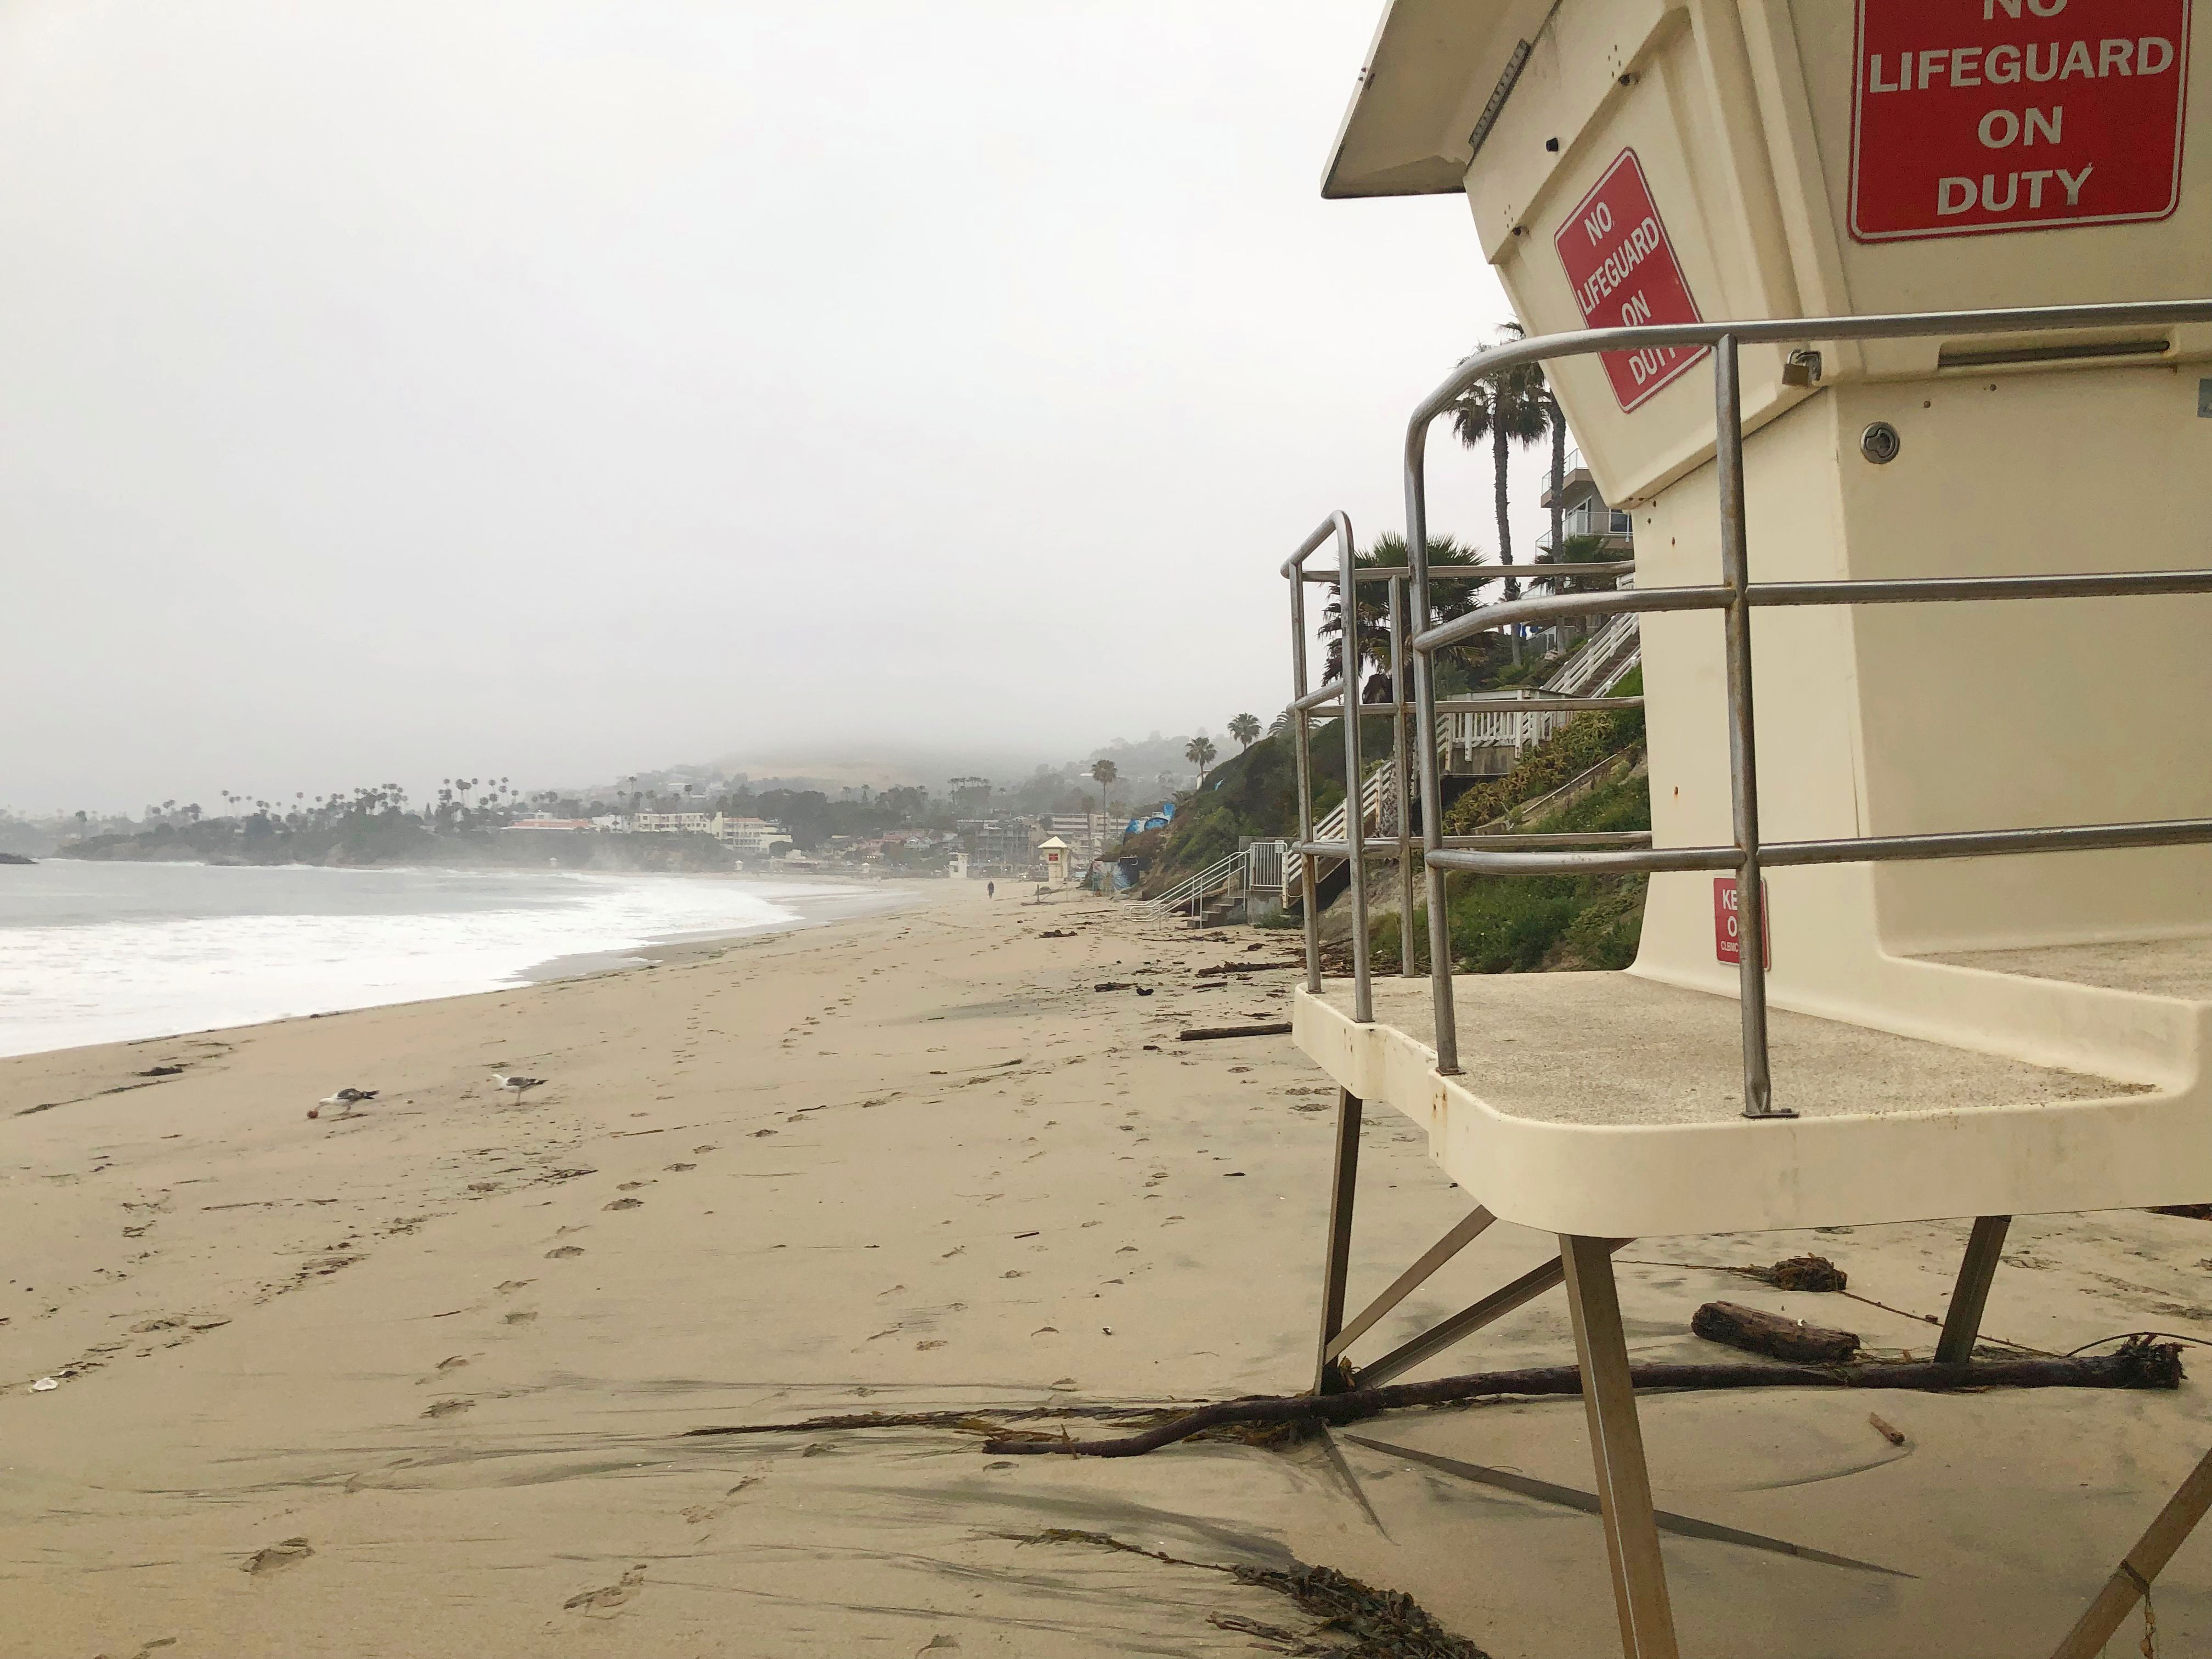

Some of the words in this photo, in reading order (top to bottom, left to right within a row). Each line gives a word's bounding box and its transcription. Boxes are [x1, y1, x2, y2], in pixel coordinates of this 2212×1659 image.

[1869, 37, 2174, 93] LIFEGUARD
[1978, 105, 2063, 149] ON
[1937, 167, 2094, 215] DUTY
[1584, 201, 1612, 246] NO
[1576, 216, 1660, 315] LIFEGUARD
[1622, 290, 1651, 326] ON
